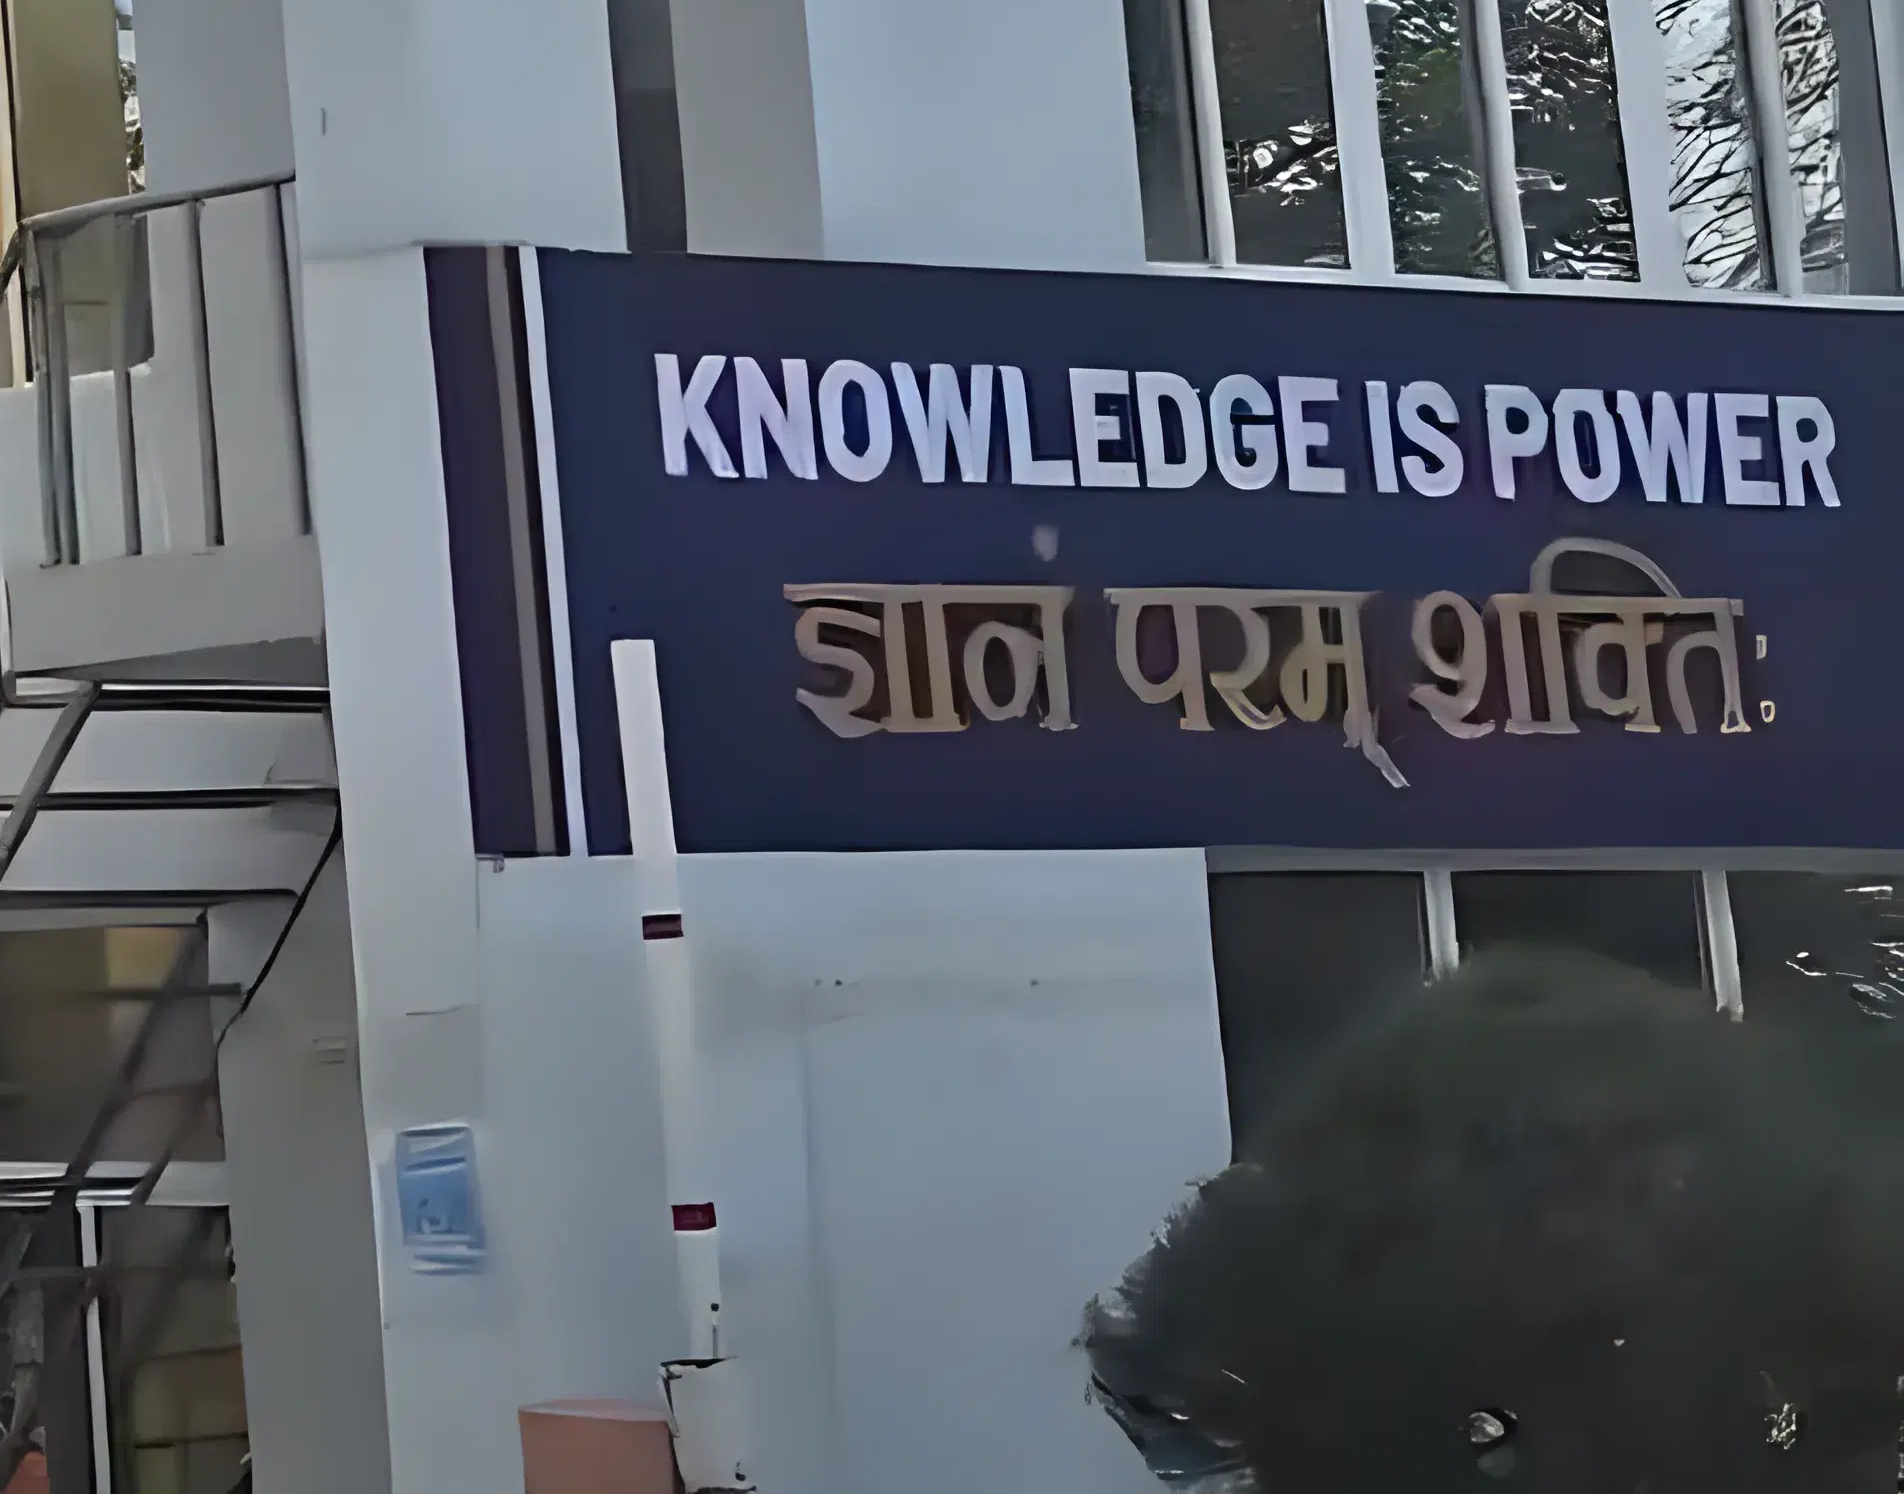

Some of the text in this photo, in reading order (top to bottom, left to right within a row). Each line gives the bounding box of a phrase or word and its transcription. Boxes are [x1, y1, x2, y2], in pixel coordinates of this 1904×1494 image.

[654, 352, 1841, 508] KNOWLEDGE IS POWER
[1102, 584, 1411, 790] परम्
